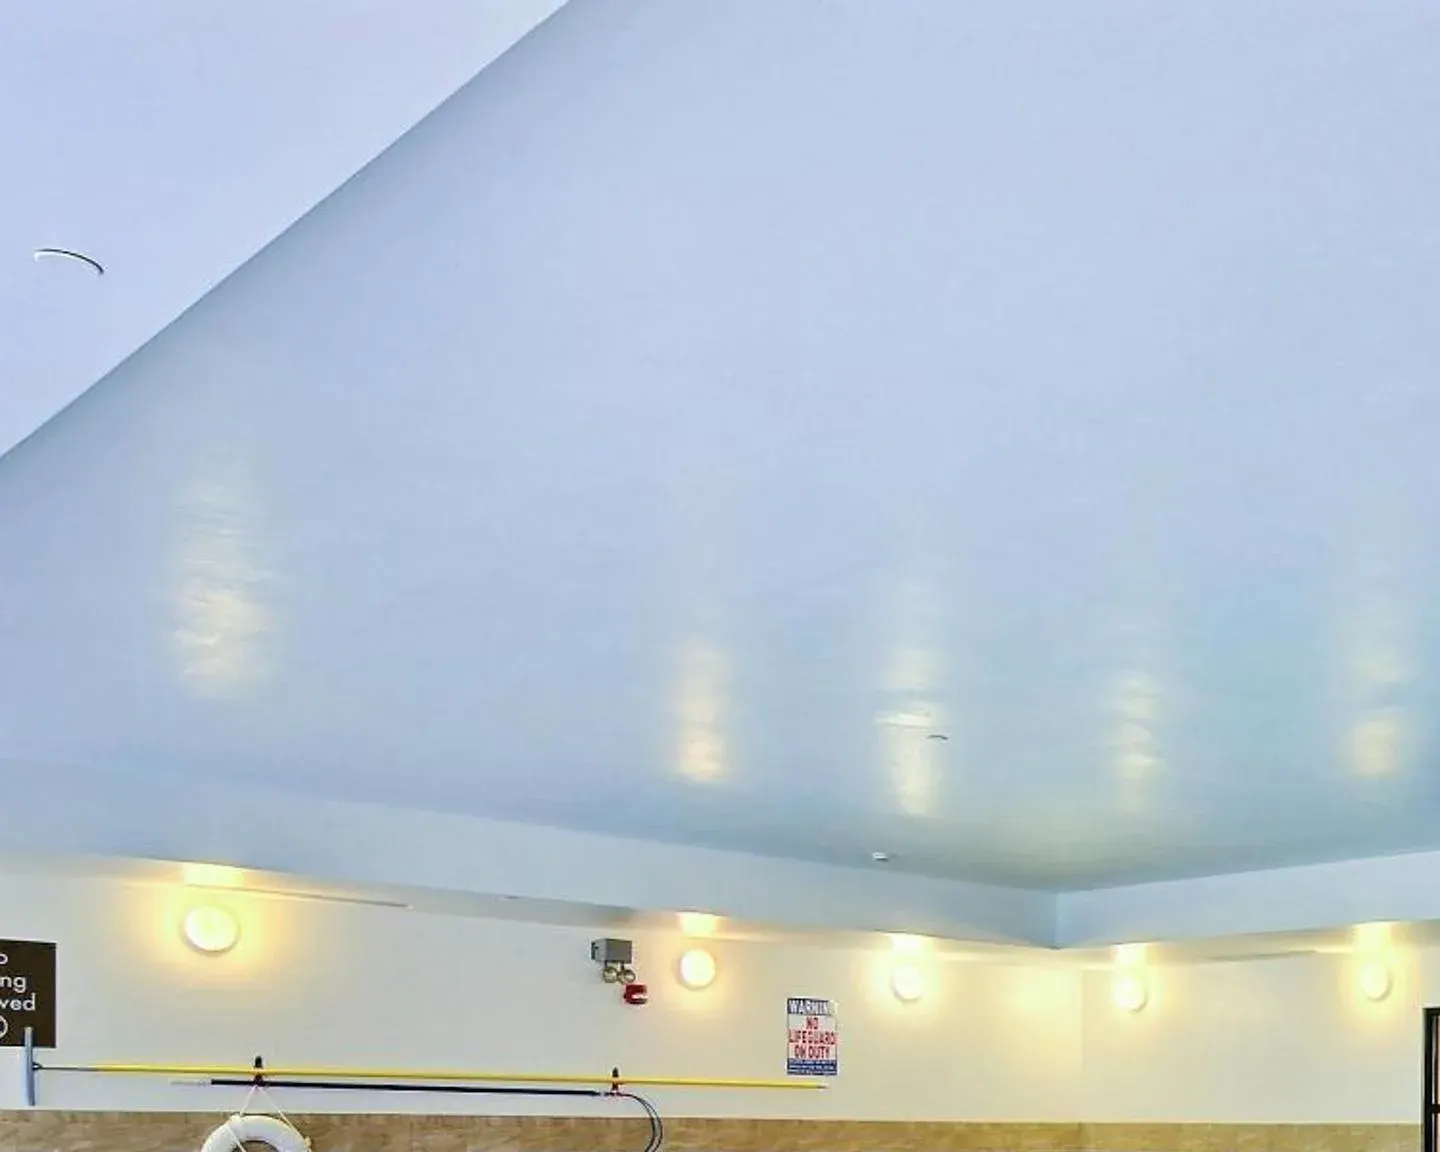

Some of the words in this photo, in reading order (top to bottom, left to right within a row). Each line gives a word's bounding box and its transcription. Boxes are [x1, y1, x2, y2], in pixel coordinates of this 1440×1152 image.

[789, 1000, 834, 1015] WARNIN
[806, 1016, 819, 1030] NO
[788, 1030, 836, 1045] LIFEGUARD
[794, 1044, 806, 1058] ON
[808, 1045, 830, 1059] DUTY
